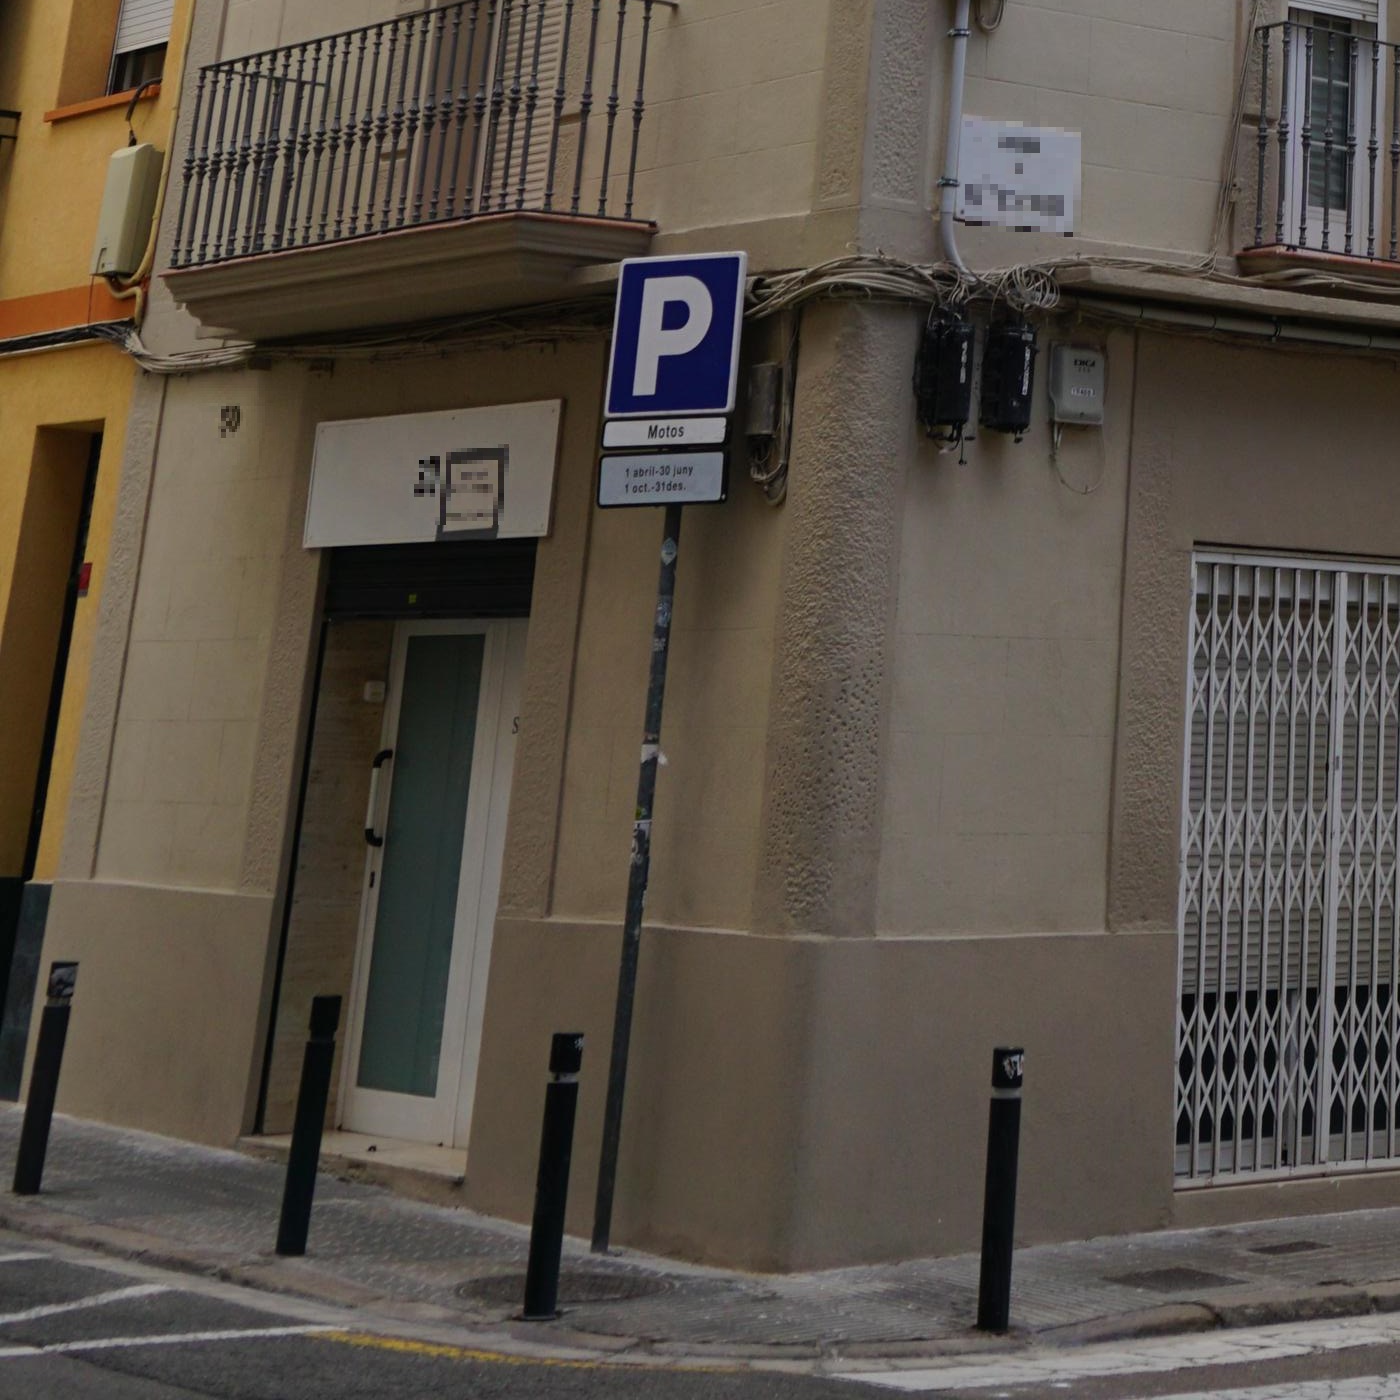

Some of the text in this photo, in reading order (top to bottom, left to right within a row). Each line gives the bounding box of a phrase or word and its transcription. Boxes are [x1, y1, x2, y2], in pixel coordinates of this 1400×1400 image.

[632, 275, 713, 397] P
[648, 425, 685, 439] Motos
[673, 464, 694, 477] juny
